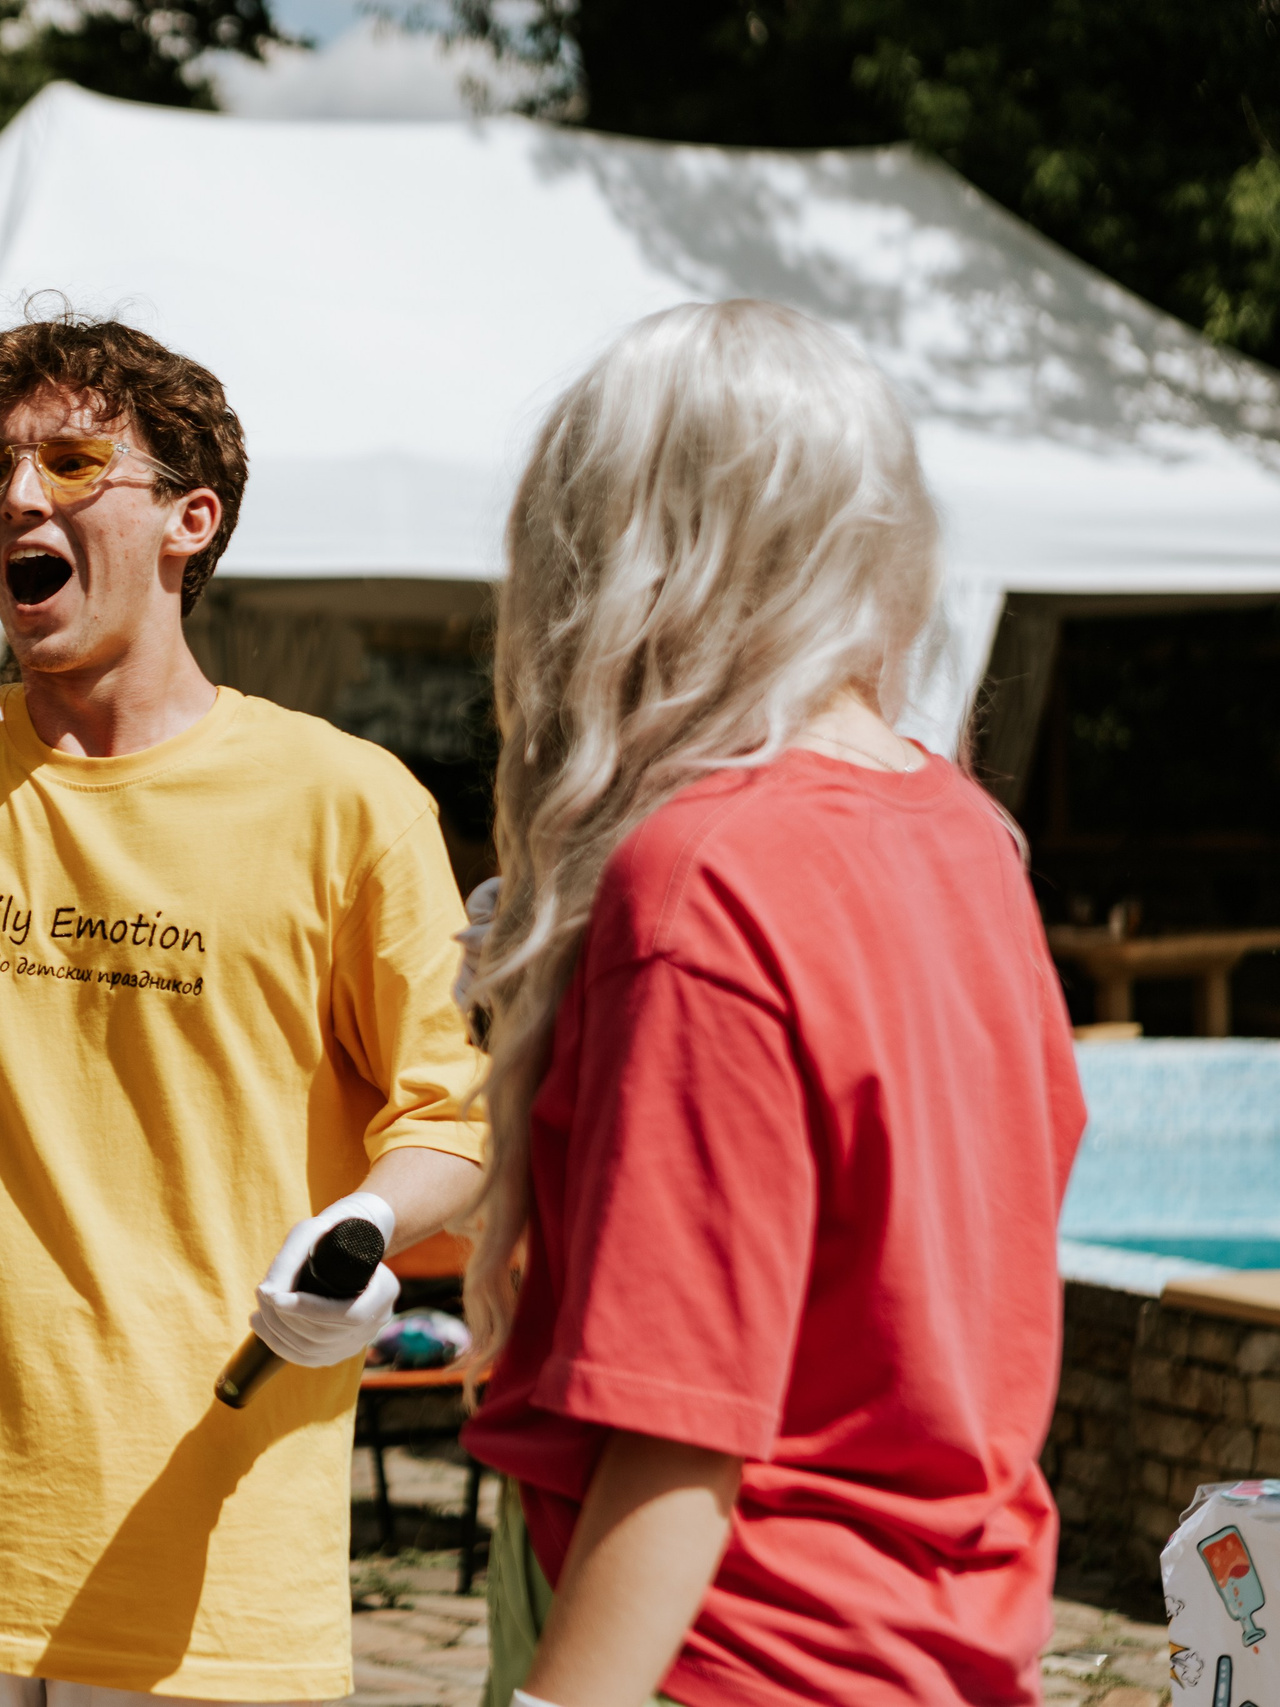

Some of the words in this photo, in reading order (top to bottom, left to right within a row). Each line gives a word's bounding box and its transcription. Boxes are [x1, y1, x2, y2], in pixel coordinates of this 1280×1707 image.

[50, 906, 206, 953] Emotion
[16, 956, 92, 983] детских
[97, 969, 204, 997] праздников
